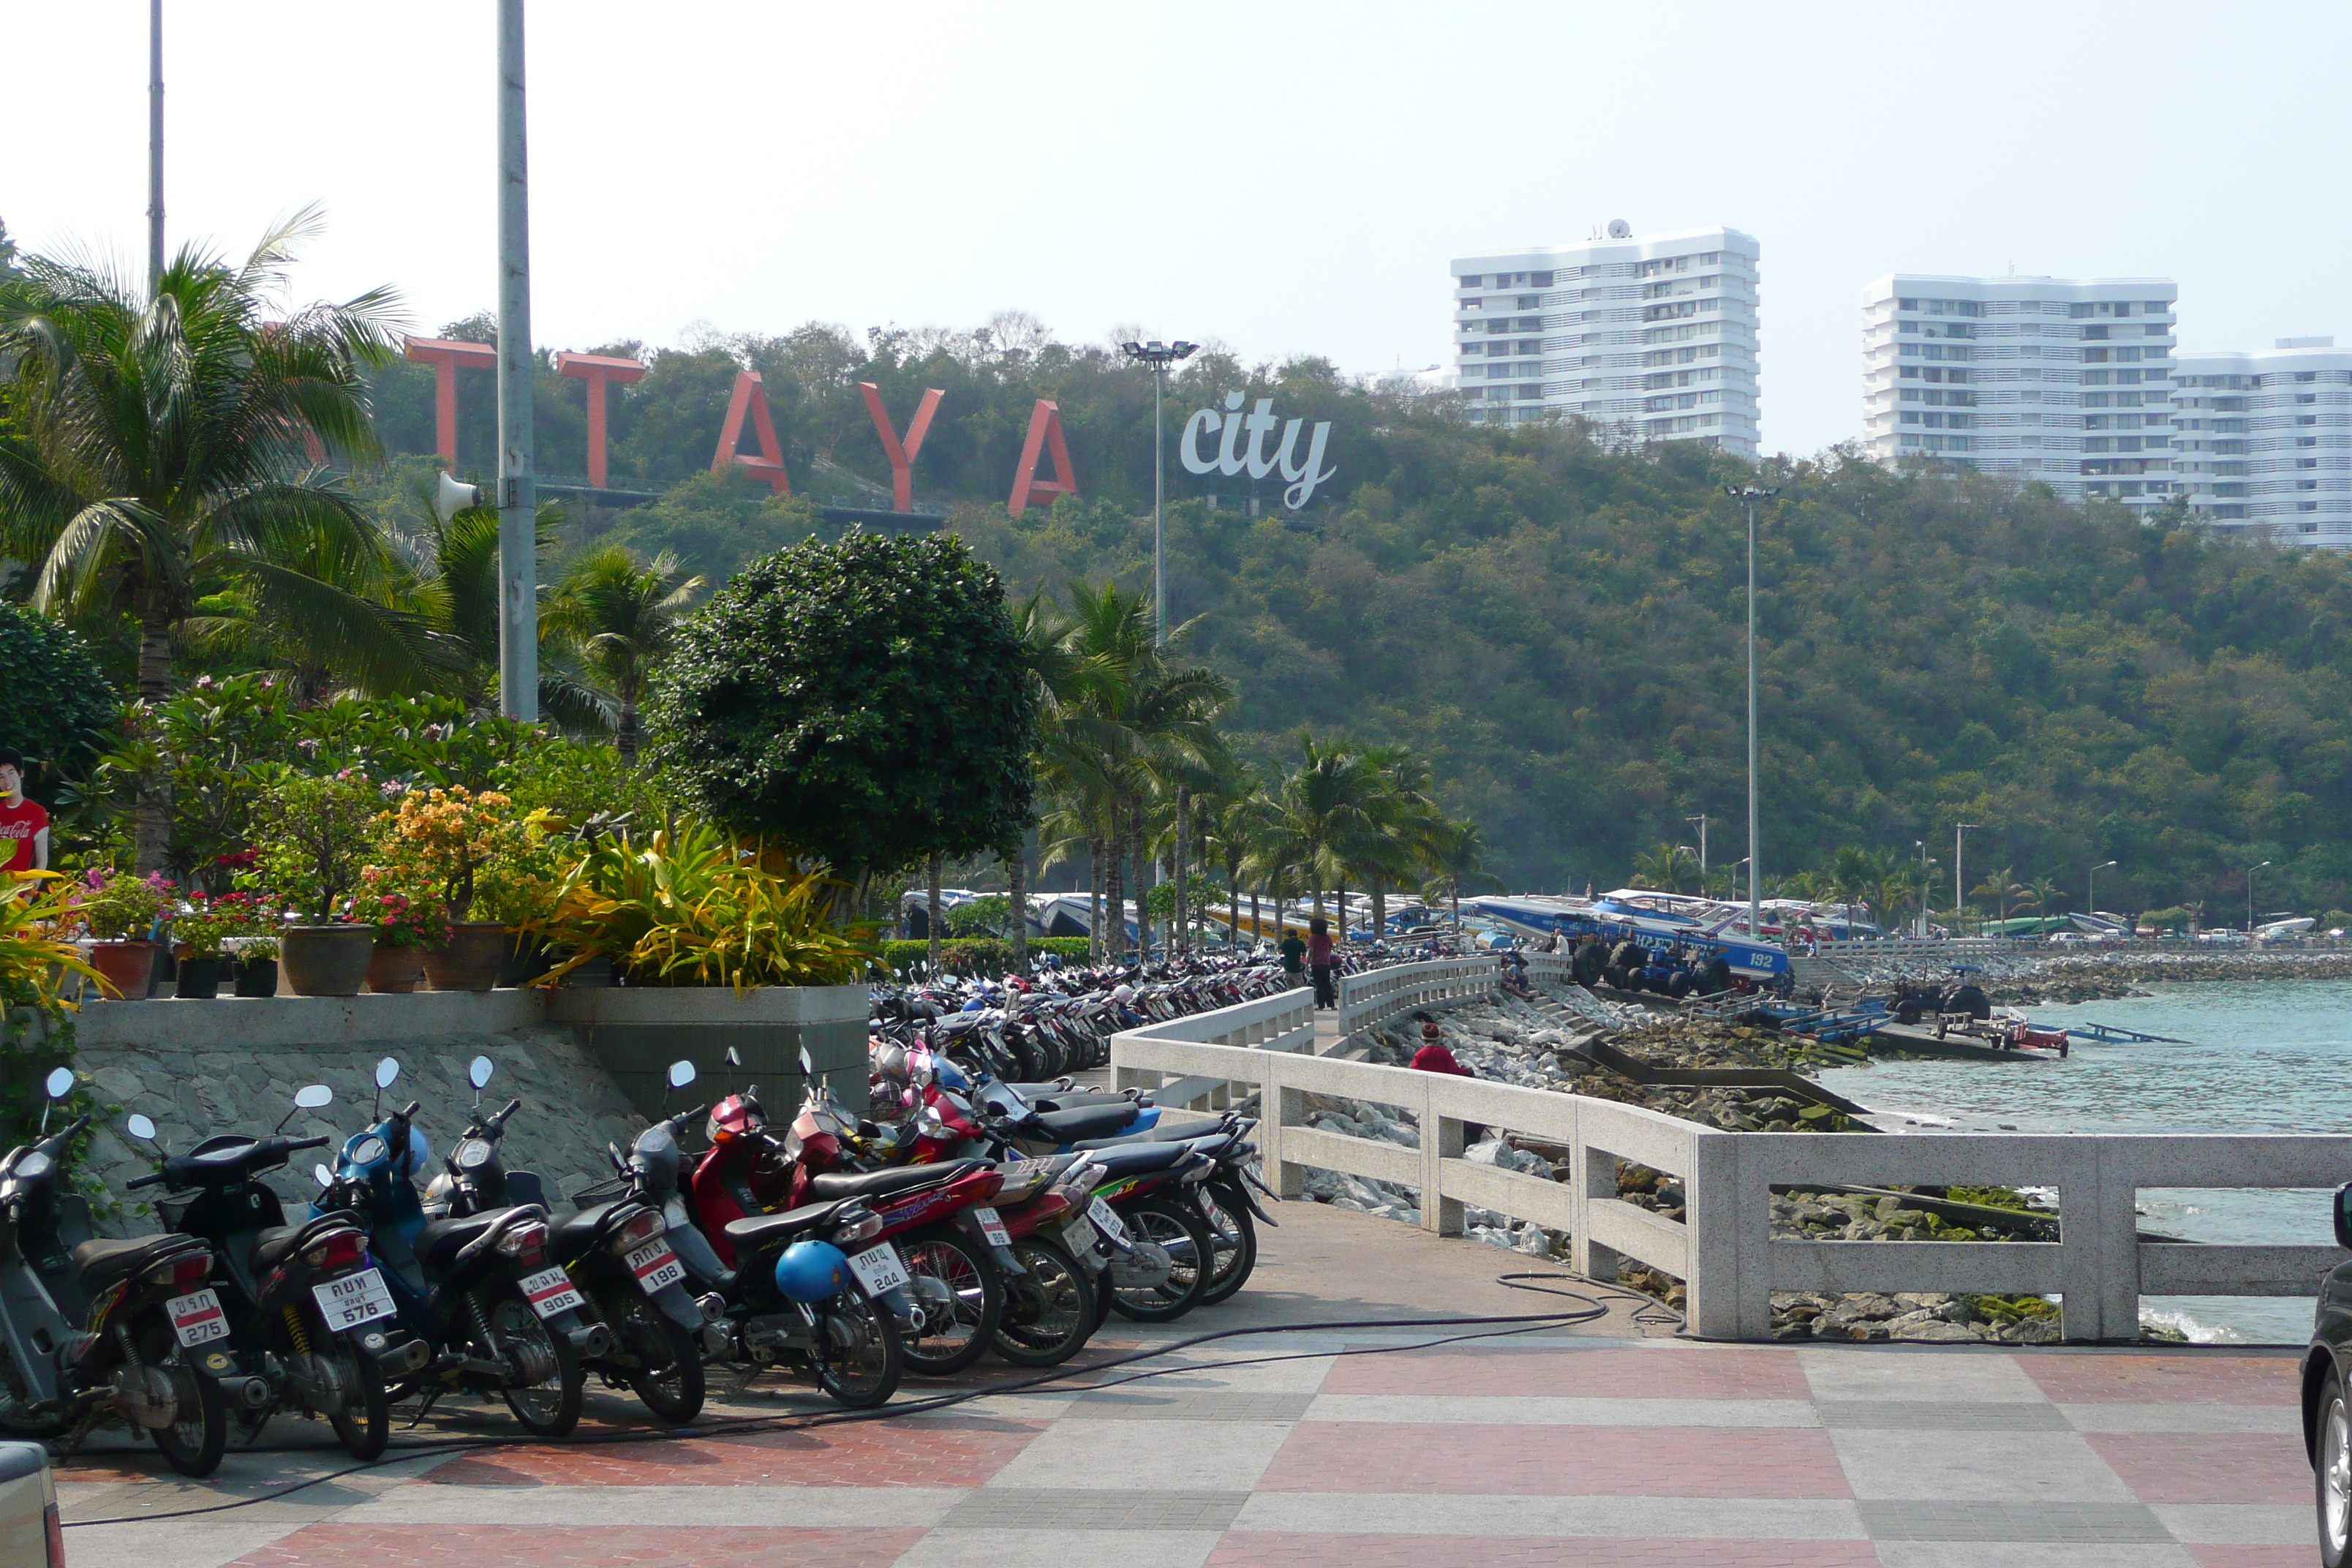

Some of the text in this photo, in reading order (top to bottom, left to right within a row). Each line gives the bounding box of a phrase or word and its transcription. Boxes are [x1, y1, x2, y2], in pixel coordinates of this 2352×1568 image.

[1180, 389, 1337, 510] city
[1750, 952, 1774, 968] 192
[649, 1265, 679, 1286] 198
[874, 1272, 900, 1290] 244
[343, 1302, 378, 1322] 576
[543, 1293, 576, 1311] 905
[186, 1322, 222, 1342] 275
